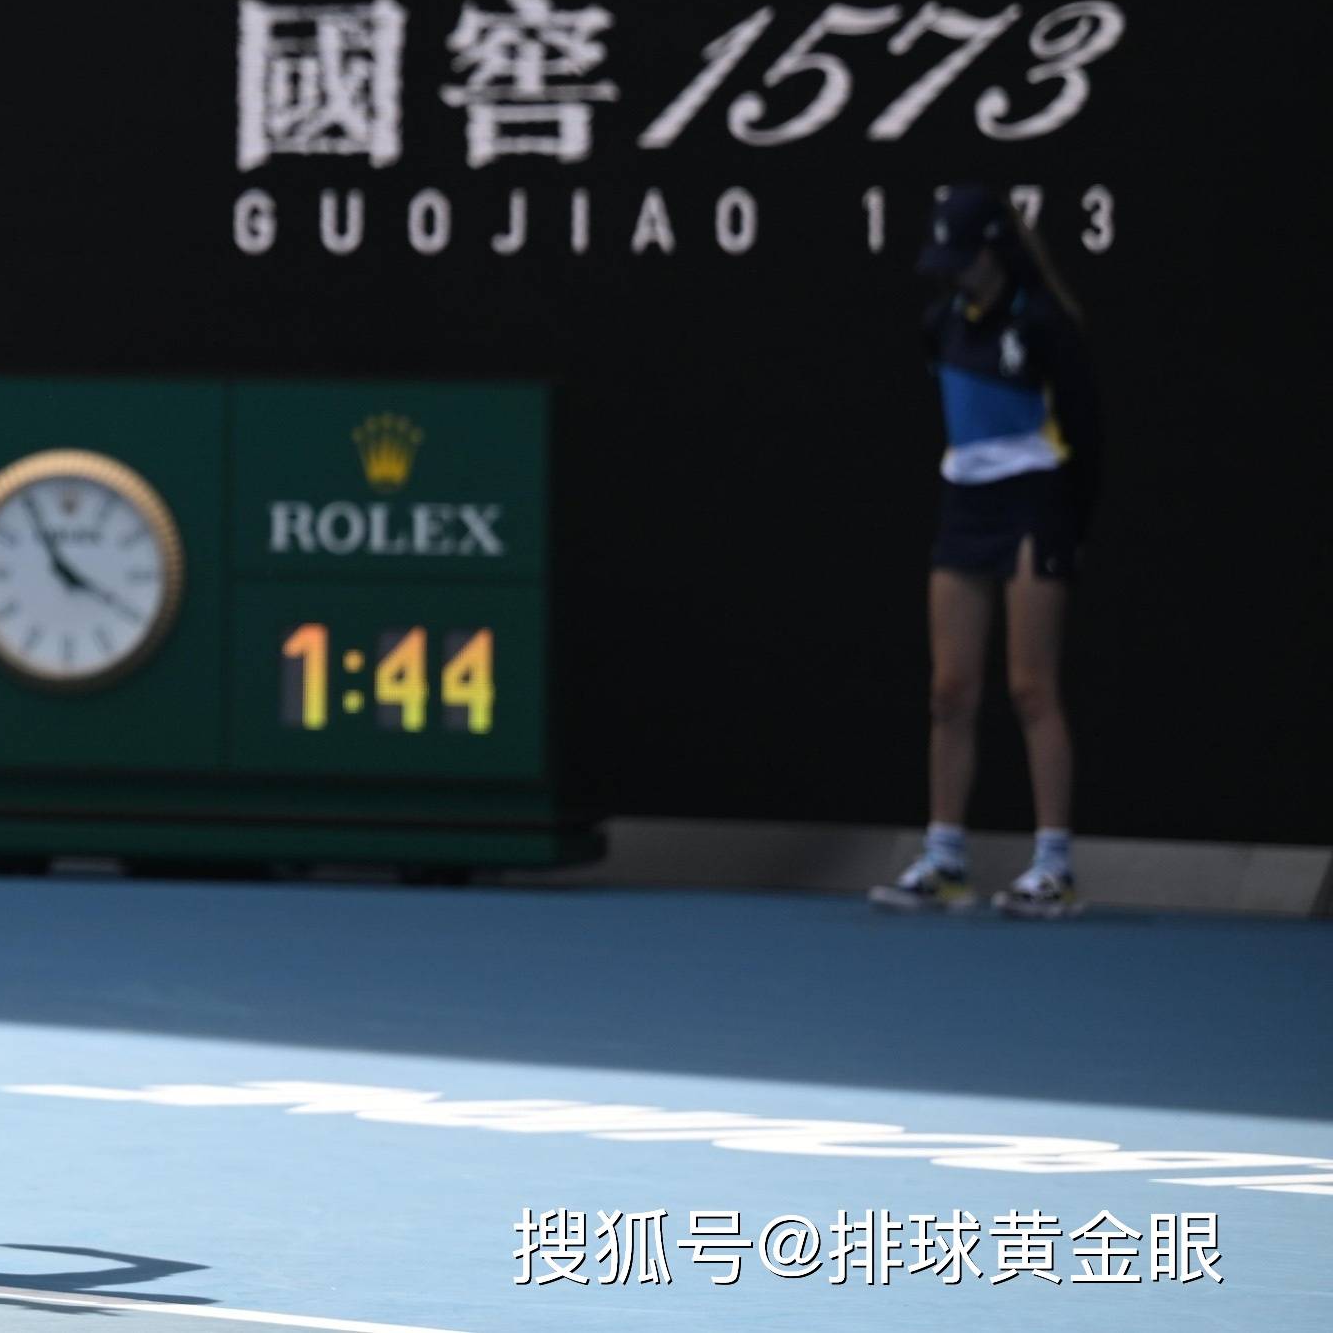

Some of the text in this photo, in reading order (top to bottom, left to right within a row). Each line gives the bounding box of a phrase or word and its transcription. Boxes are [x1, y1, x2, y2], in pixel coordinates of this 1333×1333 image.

[636, 0, 1126, 150] 1573
[232, 183, 1115, 255] GUOJIAO 173
[268, 500, 503, 557] ROLEX
[281, 623, 496, 735] 1:44
